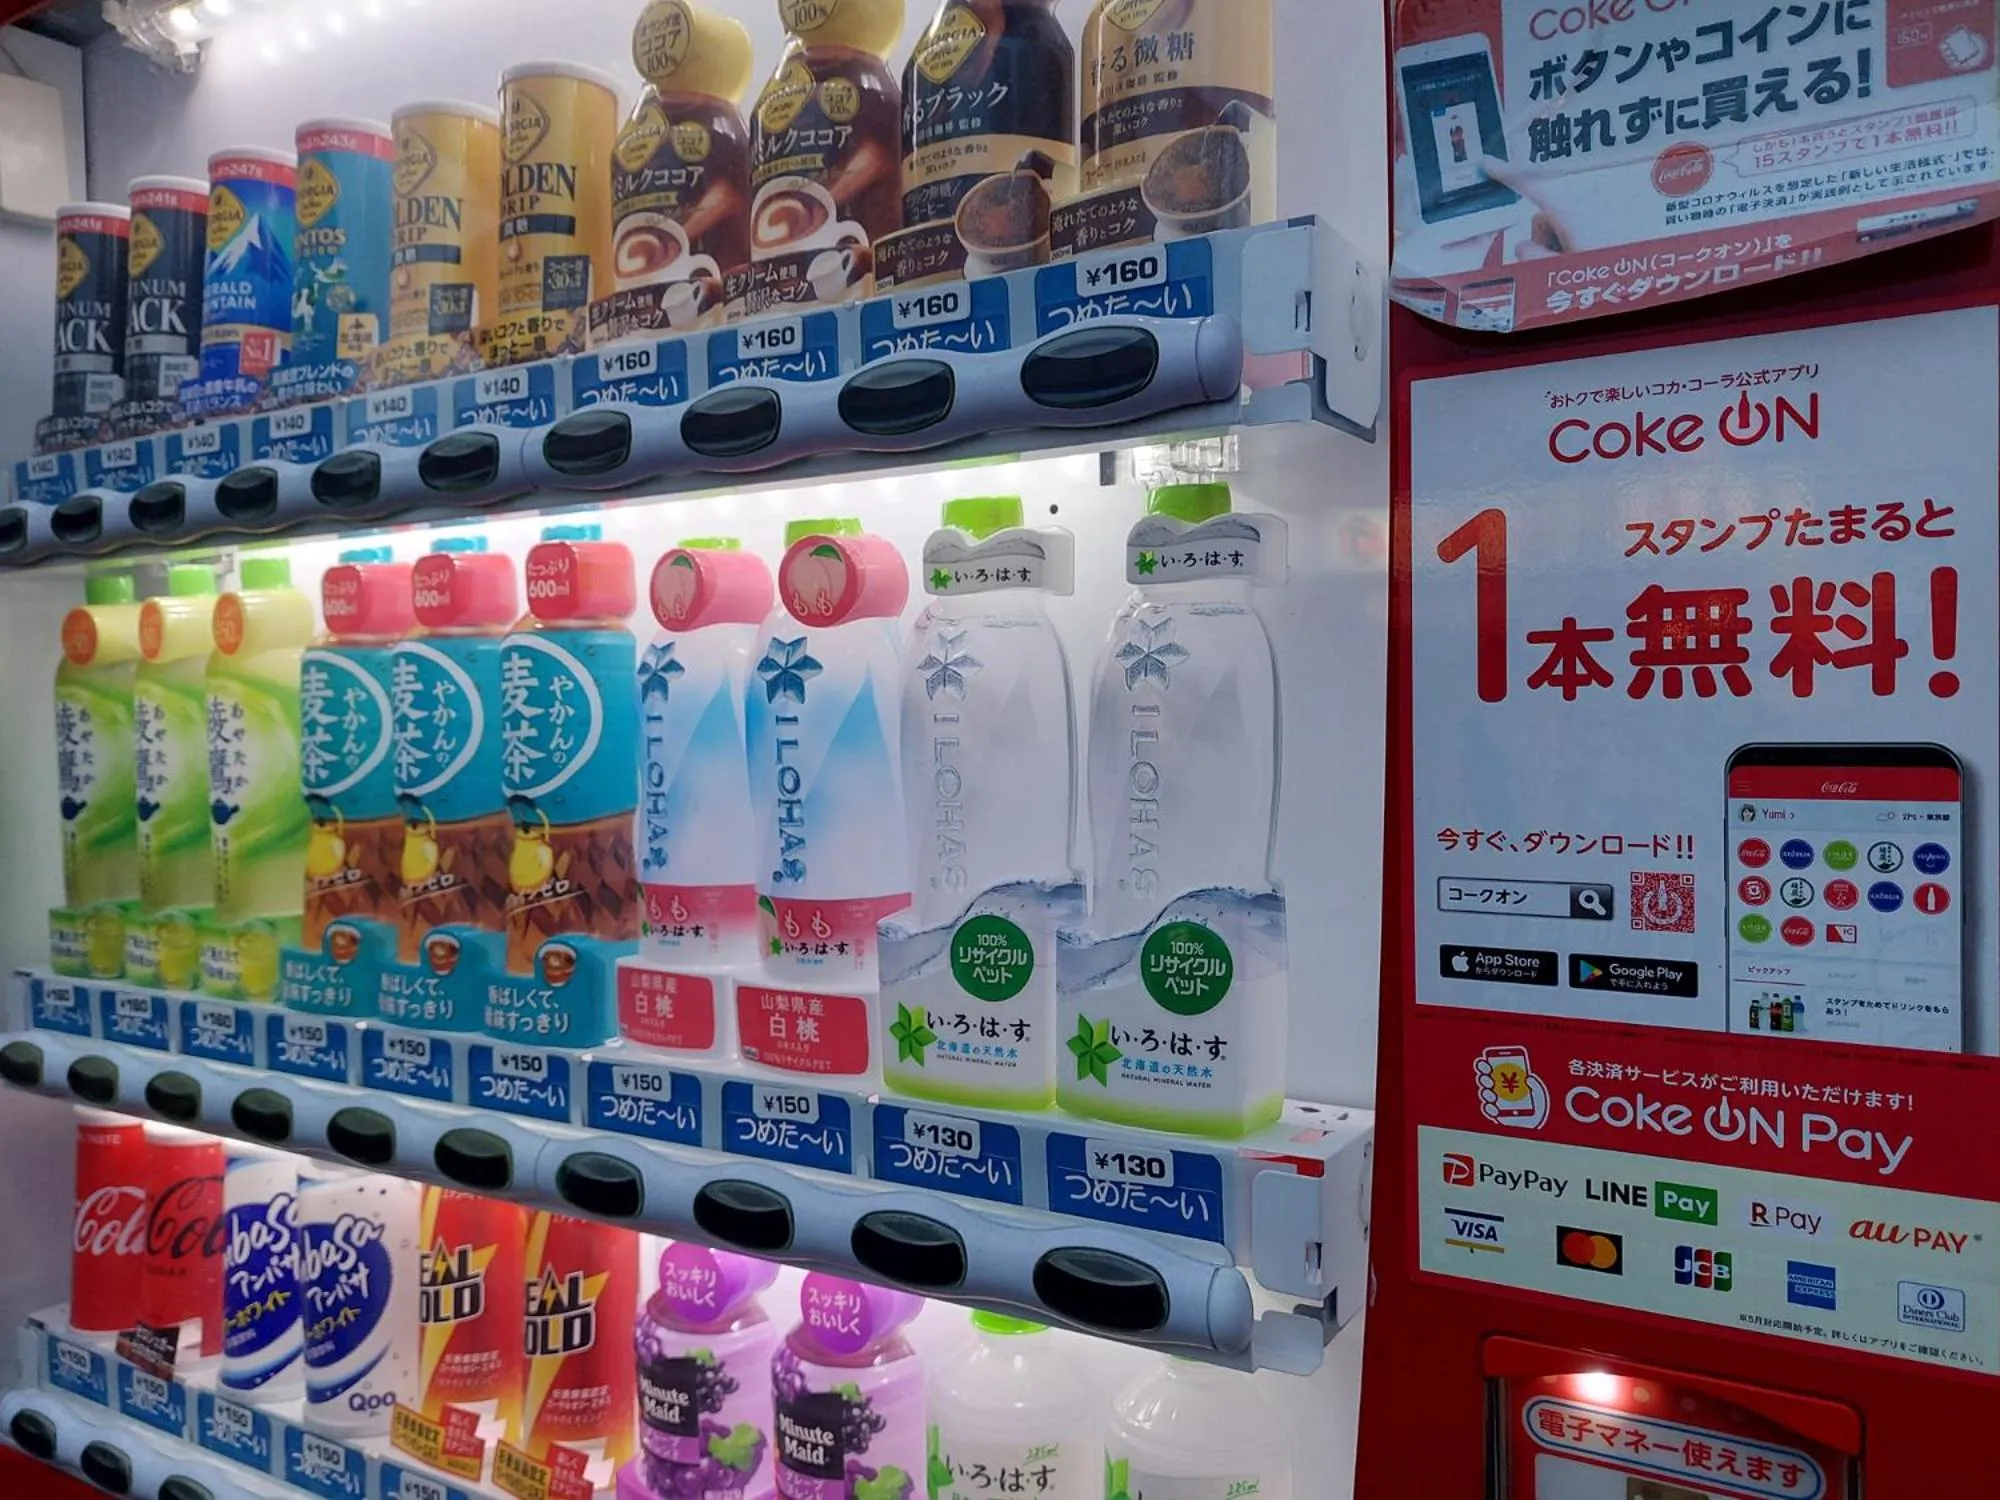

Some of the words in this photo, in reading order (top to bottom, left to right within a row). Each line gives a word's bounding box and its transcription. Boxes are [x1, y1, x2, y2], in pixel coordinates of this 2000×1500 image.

[1529, 0, 1871, 99] ボタンやコインに
[1528, 47, 1871, 162] 触れずに買える!
[1074, 217, 1136, 247] 香りとコク
[1086, 257, 1158, 288] ¥160
[1546, 247, 1823, 314] 今すぐダウンロード!!
[897, 293, 959, 319] ¥160
[742, 326, 797, 351] ¥160
[603, 350, 651, 372] ¥160
[483, 377, 521, 397] ¥140
[373, 396, 408, 414] ¥140
[1548, 411, 1705, 463] Coke
[1622, 498, 1956, 557] スタンプたまると
[527, 556, 571, 580] たっぷり
[529, 580, 571, 600] 600ml
[393, 657, 431, 785] 麦茶
[432, 680, 458, 768] やかんの
[502, 651, 548, 784] 麦茶
[548, 674, 577, 766] やかんの
[775, 737, 807, 884] LOHAS
[1762, 807, 1786, 820] Yumi
[1448, 888, 1528, 905] コークオン
[783, 908, 833, 939] もも
[978, 933, 1008, 946] 100%
[1170, 941, 1204, 955] 100%
[959, 946, 1027, 968] リサイクル
[1149, 953, 1226, 978] リサイクル
[1475, 951, 1504, 968] App
[1507, 954, 1541, 970] Store
[971, 965, 1013, 985] ペット
[1165, 975, 1209, 996] ペット
[1608, 963, 1656, 980] Google
[1658, 965, 1683, 983] Play
[635, 994, 675, 1020] 白桃
[760, 993, 825, 1016] 山梨県産
[769, 1015, 821, 1044] 白桃
[388, 1037, 427, 1060] ¥150
[936, 1039, 1019, 1059] 北海道の天然水
[501, 1055, 544, 1079] ¥150
[1120, 1056, 1213, 1078] 北海道の天然水
[480, 1075, 567, 1108] つめた〜い
[622, 1073, 663, 1093] ¥150
[1568, 1059, 1915, 1111] 各決済サービスがご利用いただけます!
[600, 1094, 697, 1130] つめた〜い
[763, 1094, 812, 1116] ¥150
[737, 1117, 844, 1156] つめた〜い
[913, 1120, 975, 1152] ¥130
[1565, 1086, 1694, 1138] Coke
[1801, 1112, 1914, 1175] Pay
[889, 1143, 1013, 1185] つめた〜い
[1093, 1150, 1167, 1189] ¥130
[1479, 1163, 1568, 1199] PayPay
[1063, 1174, 1209, 1222] つめた〜い
[1585, 1179, 1648, 1208] LINE
[1664, 1189, 1711, 1219] Pay
[1450, 1218, 1499, 1241] VISA
[1775, 1205, 1822, 1235] Pay
[1848, 1219, 1910, 1245] au
[1913, 1226, 1968, 1255] PAY
[665, 1261, 717, 1292] スッキリ
[1674, 1259, 1730, 1279] JCB
[1788, 1273, 1834, 1289] AMERICAN
[665, 1281, 717, 1308] おいしく
[807, 1286, 862, 1316] スッキリ
[809, 1309, 862, 1337] おいしく
[1938, 1308, 1960, 1321] Club
[348, 1390, 397, 1412] Qoo
[643, 1397, 682, 1425] Maid
[780, 1410, 835, 1447] Minute
[305, 1441, 342, 1465] ¥150
[784, 1438, 826, 1472] Maid
[1538, 1407, 1806, 1488] 電子マネー使えます
